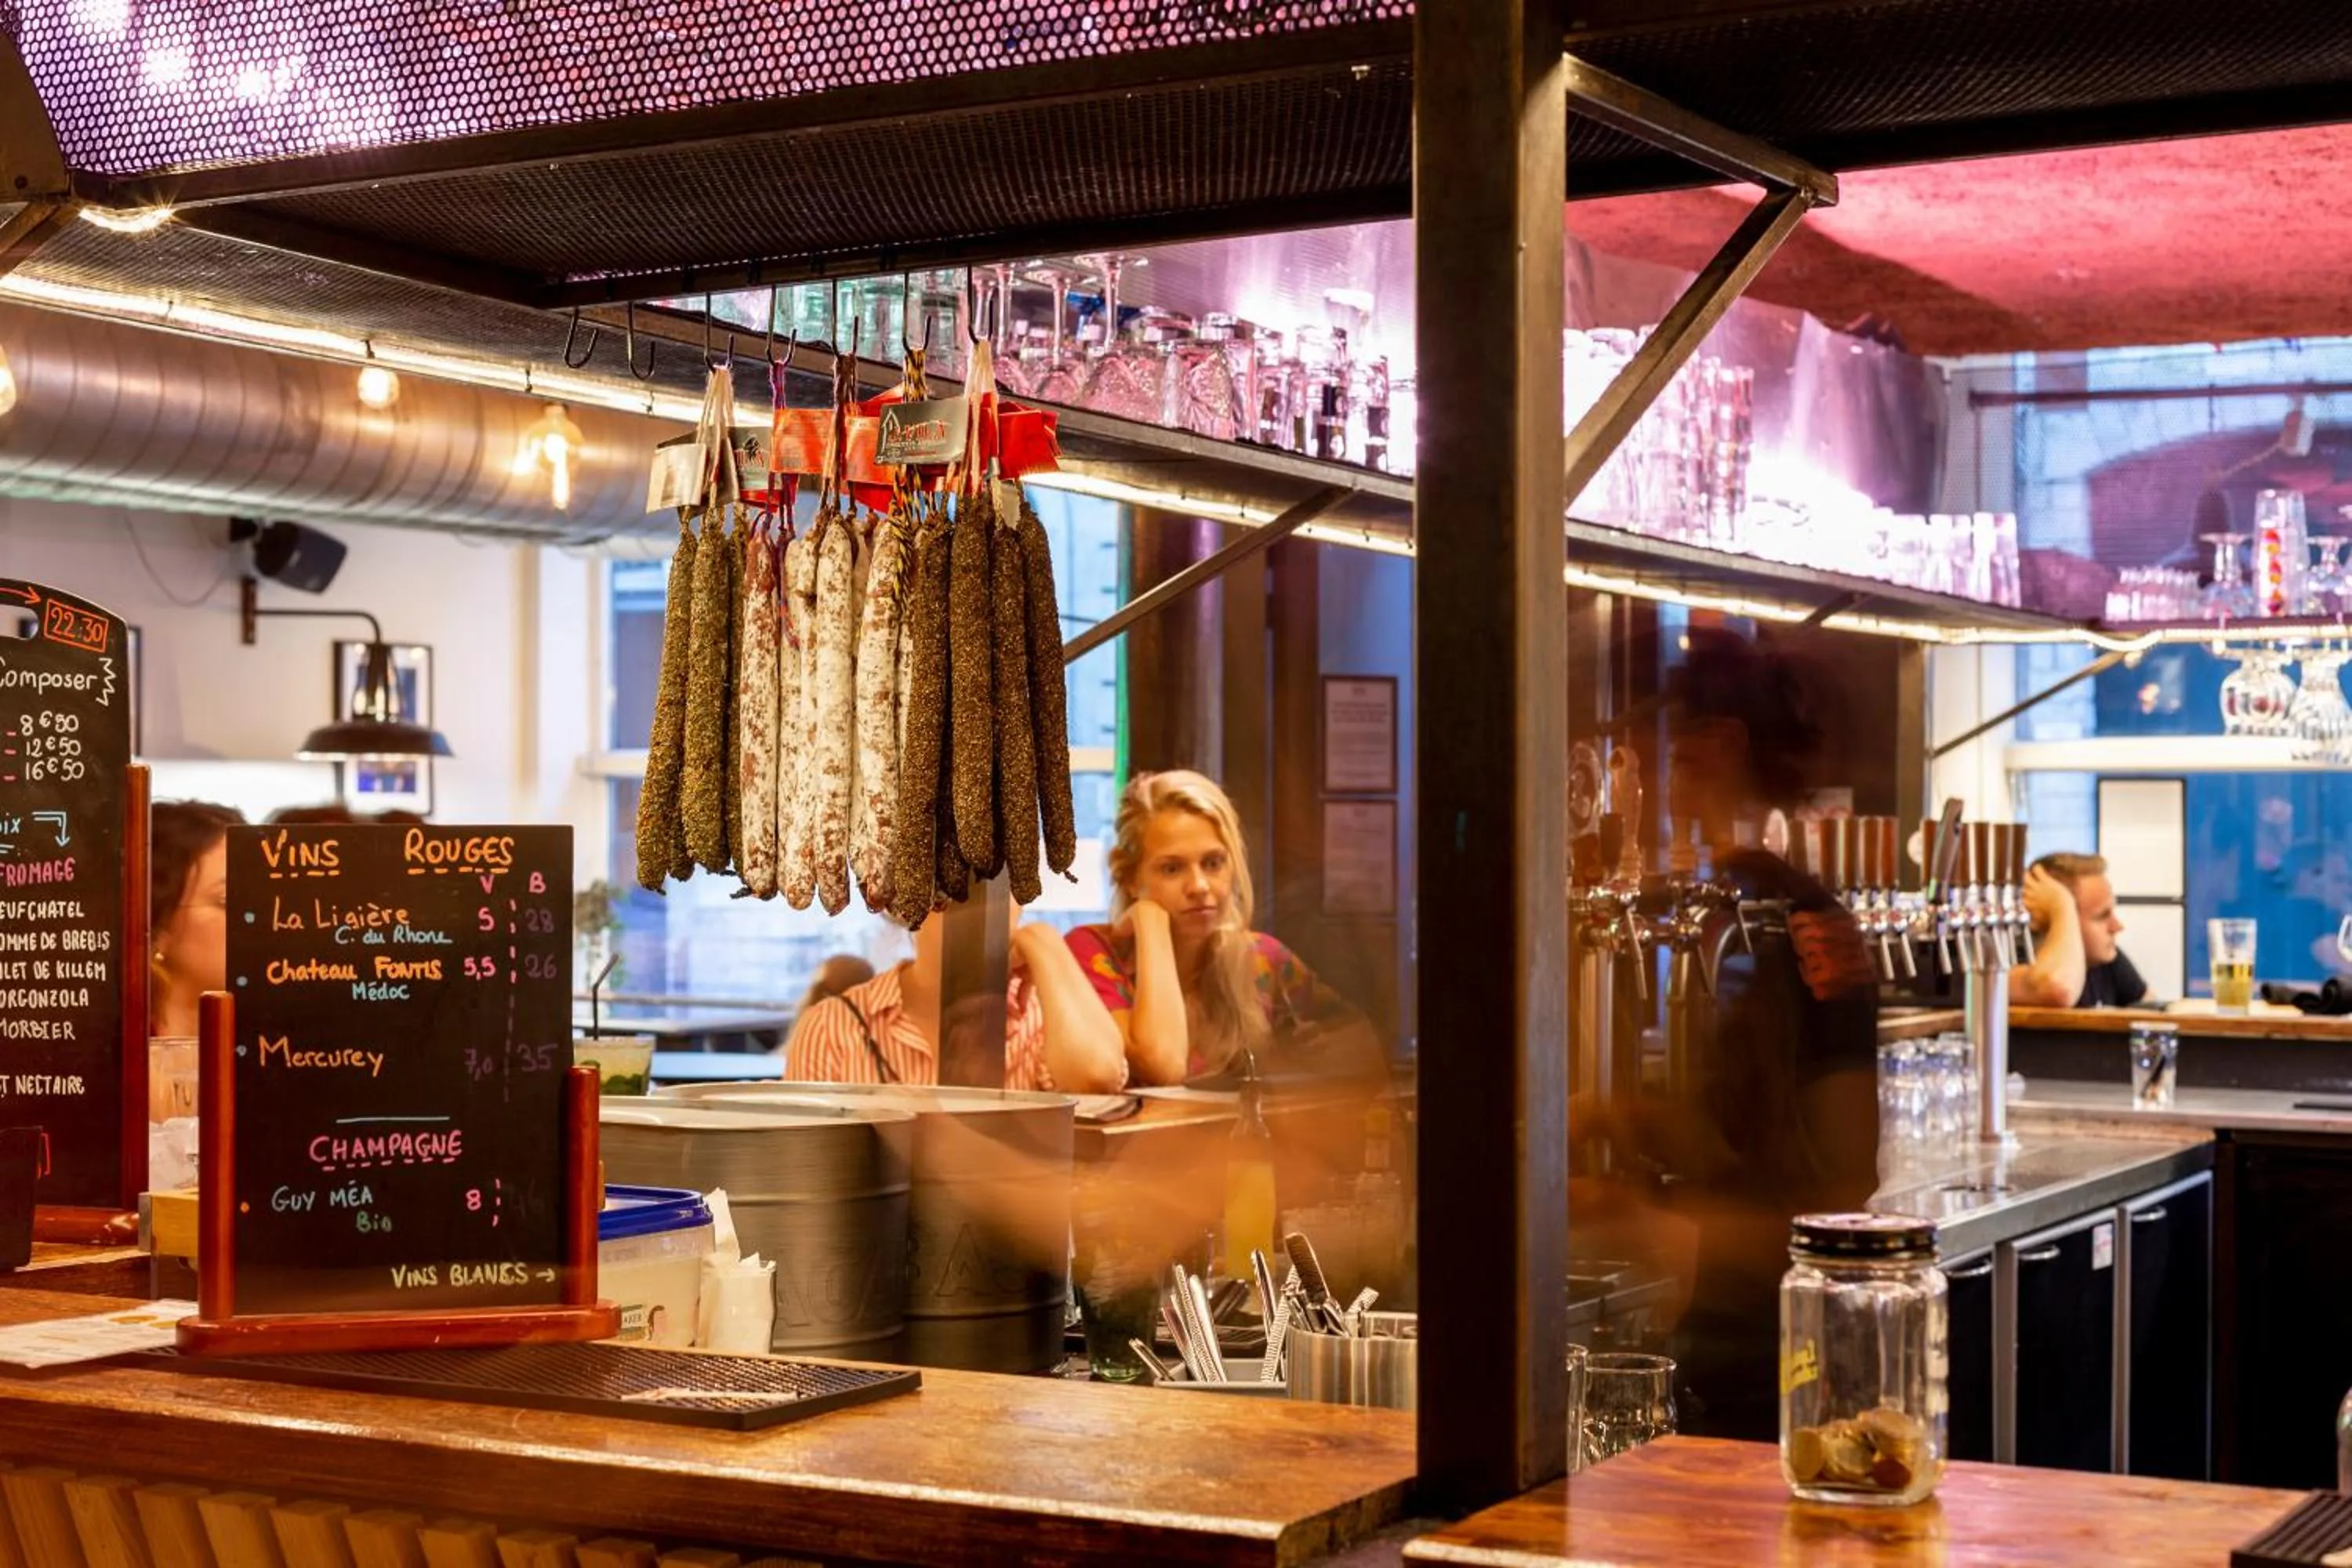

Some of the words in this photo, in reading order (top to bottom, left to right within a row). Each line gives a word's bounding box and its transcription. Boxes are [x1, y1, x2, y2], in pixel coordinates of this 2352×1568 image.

[0, 811, 21, 835] ix
[261, 828, 340, 869] VINS
[404, 827, 515, 866] ROUGES
[479, 873, 495, 895] V
[528, 872, 547, 895] B
[0, 900, 85, 921] EUFCHATEL
[271, 896, 305, 932] La
[524, 907, 555, 933] 28
[40, 931, 57, 950] DE
[61, 928, 111, 952] BREBIS
[334, 924, 356, 946] C.
[361, 927, 387, 946] du
[32, 960, 51, 980] DE
[55, 959, 107, 982] KILLEM
[265, 957, 358, 985] Chateau
[463, 956, 497, 981] 5,5
[523, 953, 558, 980] 26
[0, 988, 89, 1009] ORGONZOLA
[257, 1034, 385, 1078] Mercurey
[516, 1042, 559, 1073] 35
[15, 1073, 86, 1095] NECTAIRE
[308, 1129, 463, 1163] CHAMPAGNE
[465, 1189, 483, 1210] 8
[391, 1263, 439, 1290] VINS
